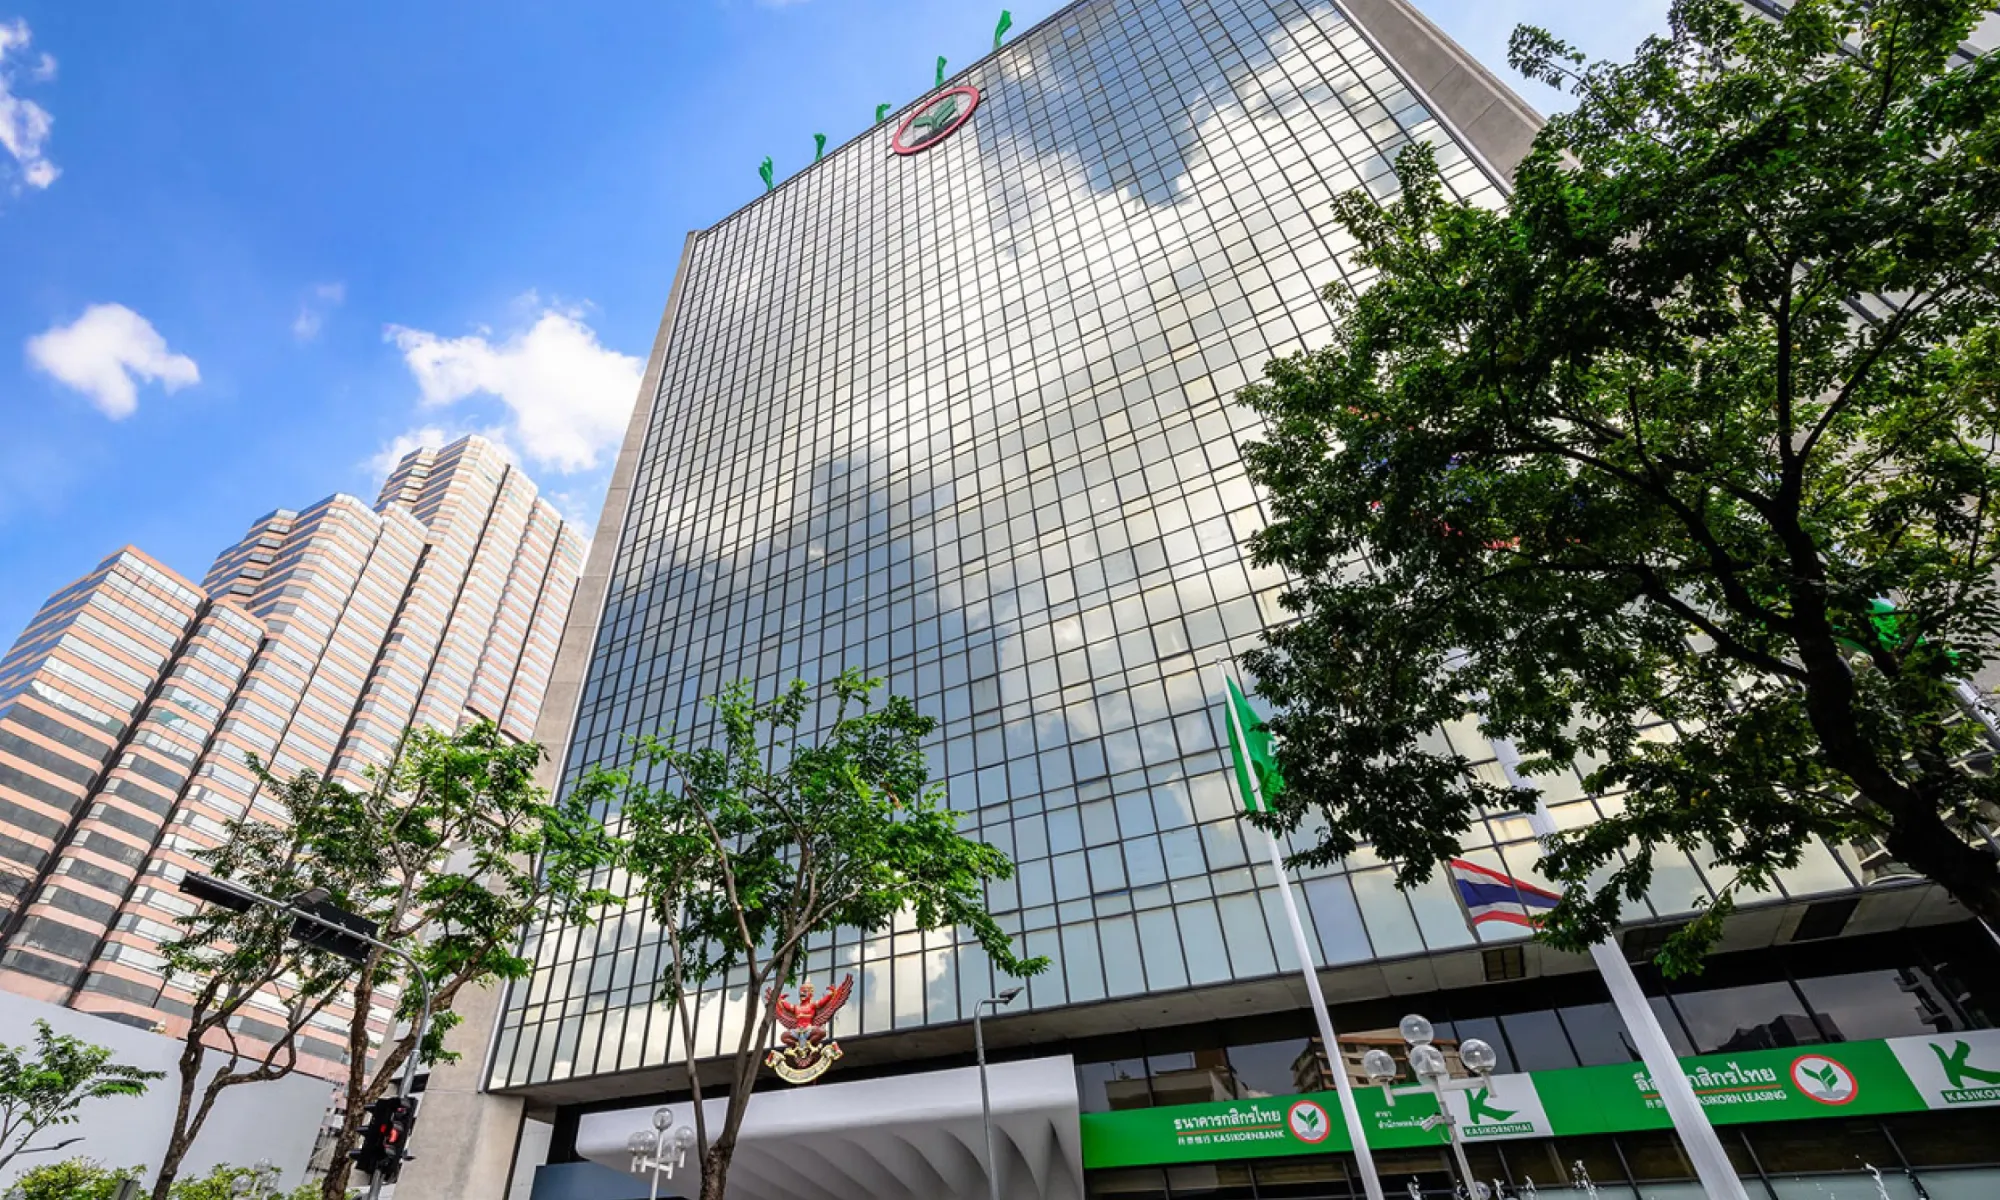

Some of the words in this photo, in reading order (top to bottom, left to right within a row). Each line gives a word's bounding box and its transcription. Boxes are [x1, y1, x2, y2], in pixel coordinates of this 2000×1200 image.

[1742, 1089, 1787, 1103] LEASING
[1174, 1104, 1282, 1130] ธนาคารกสิกรไทย
[1213, 1130, 1285, 1143] KASIKORNBANK
